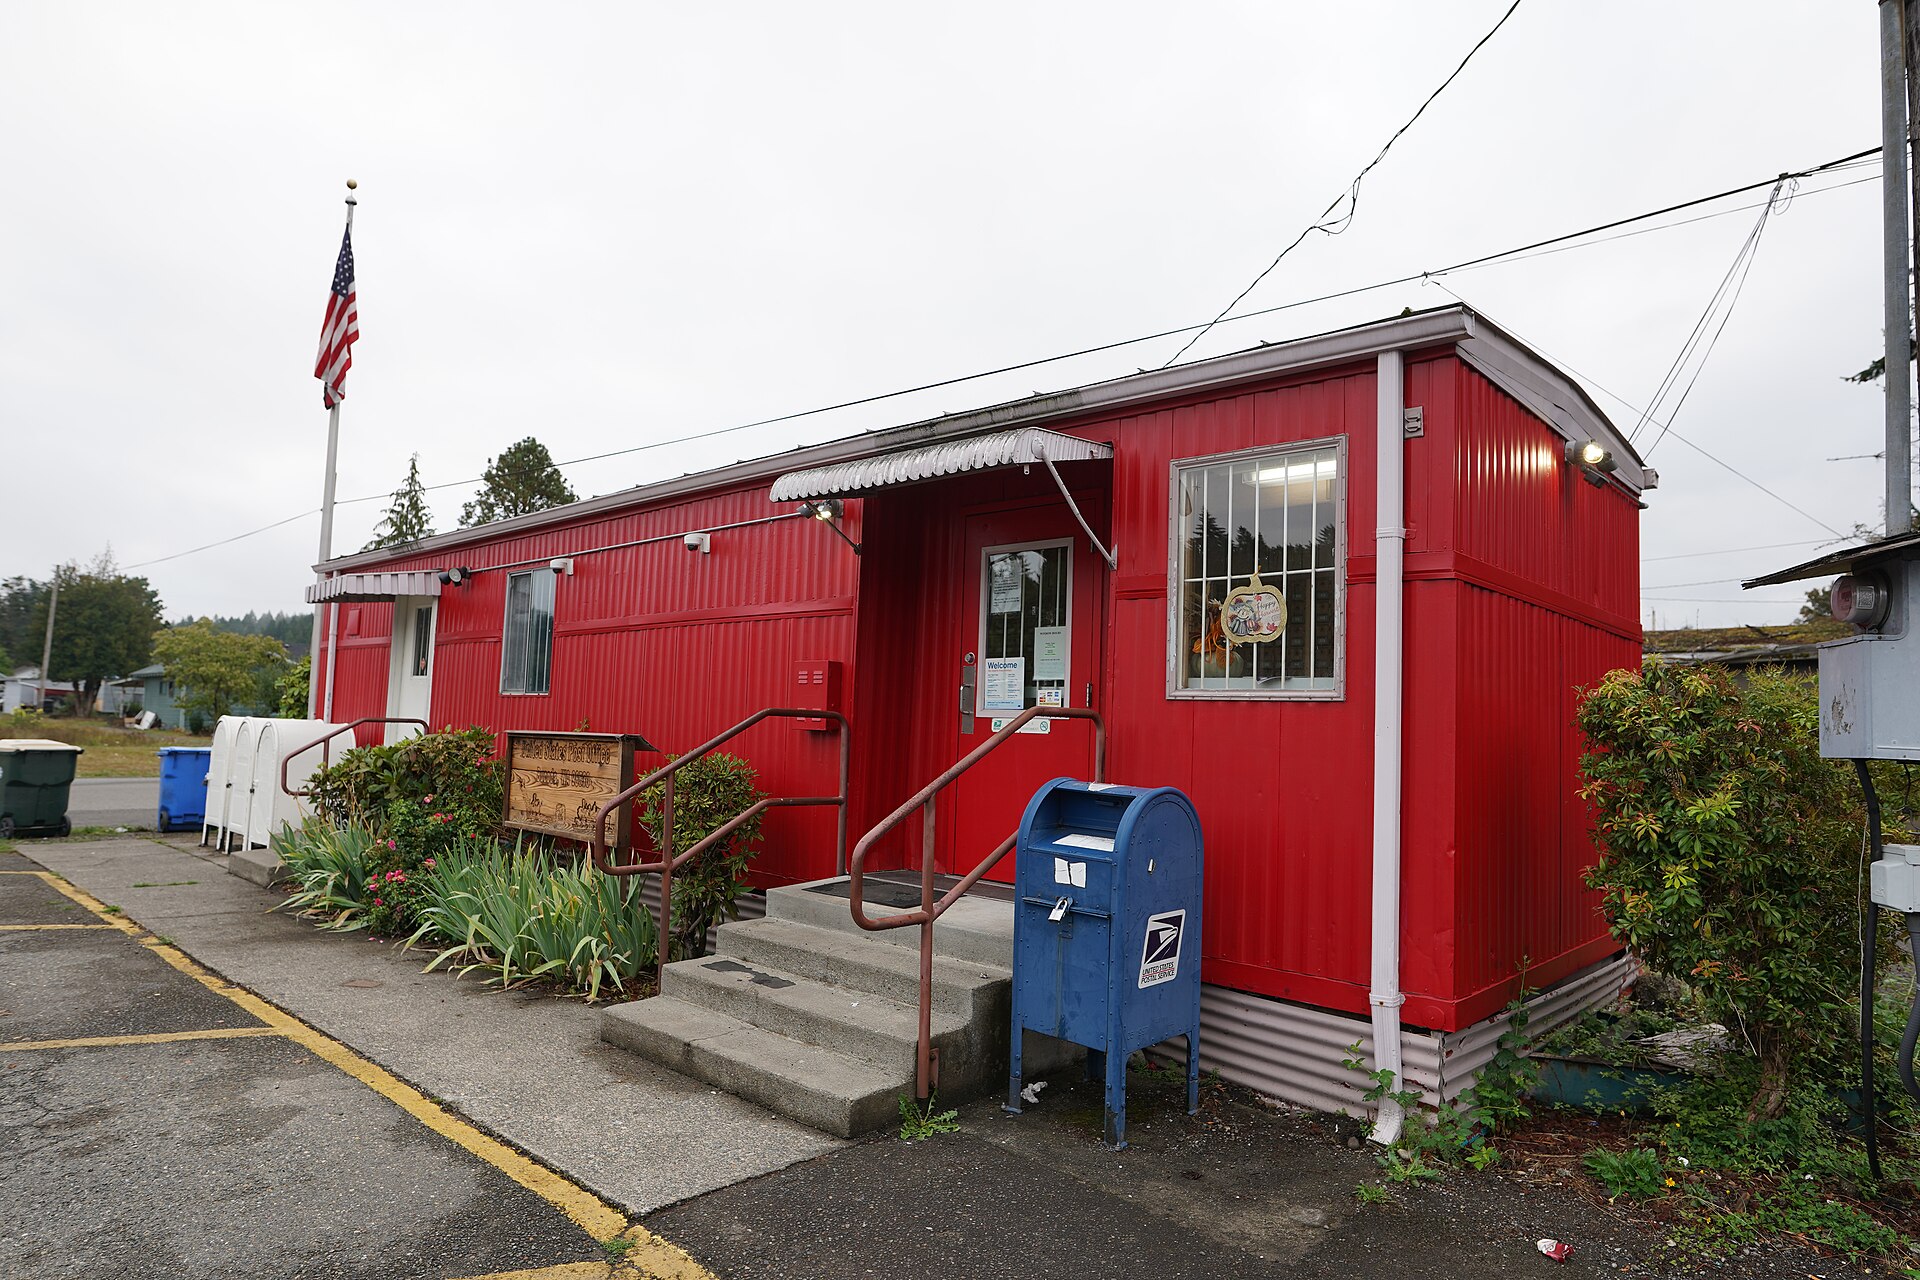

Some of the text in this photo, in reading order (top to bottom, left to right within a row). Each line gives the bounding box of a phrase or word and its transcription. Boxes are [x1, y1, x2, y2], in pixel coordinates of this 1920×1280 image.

[987, 661, 1018, 670] Welcome
[543, 741, 567, 761] States
[568, 742, 586, 762] Post
[585, 742, 611, 765] Office
[1142, 962, 1174, 975] UNITED STATES
[1140, 970, 1175, 984] POSTAL SERVICE
